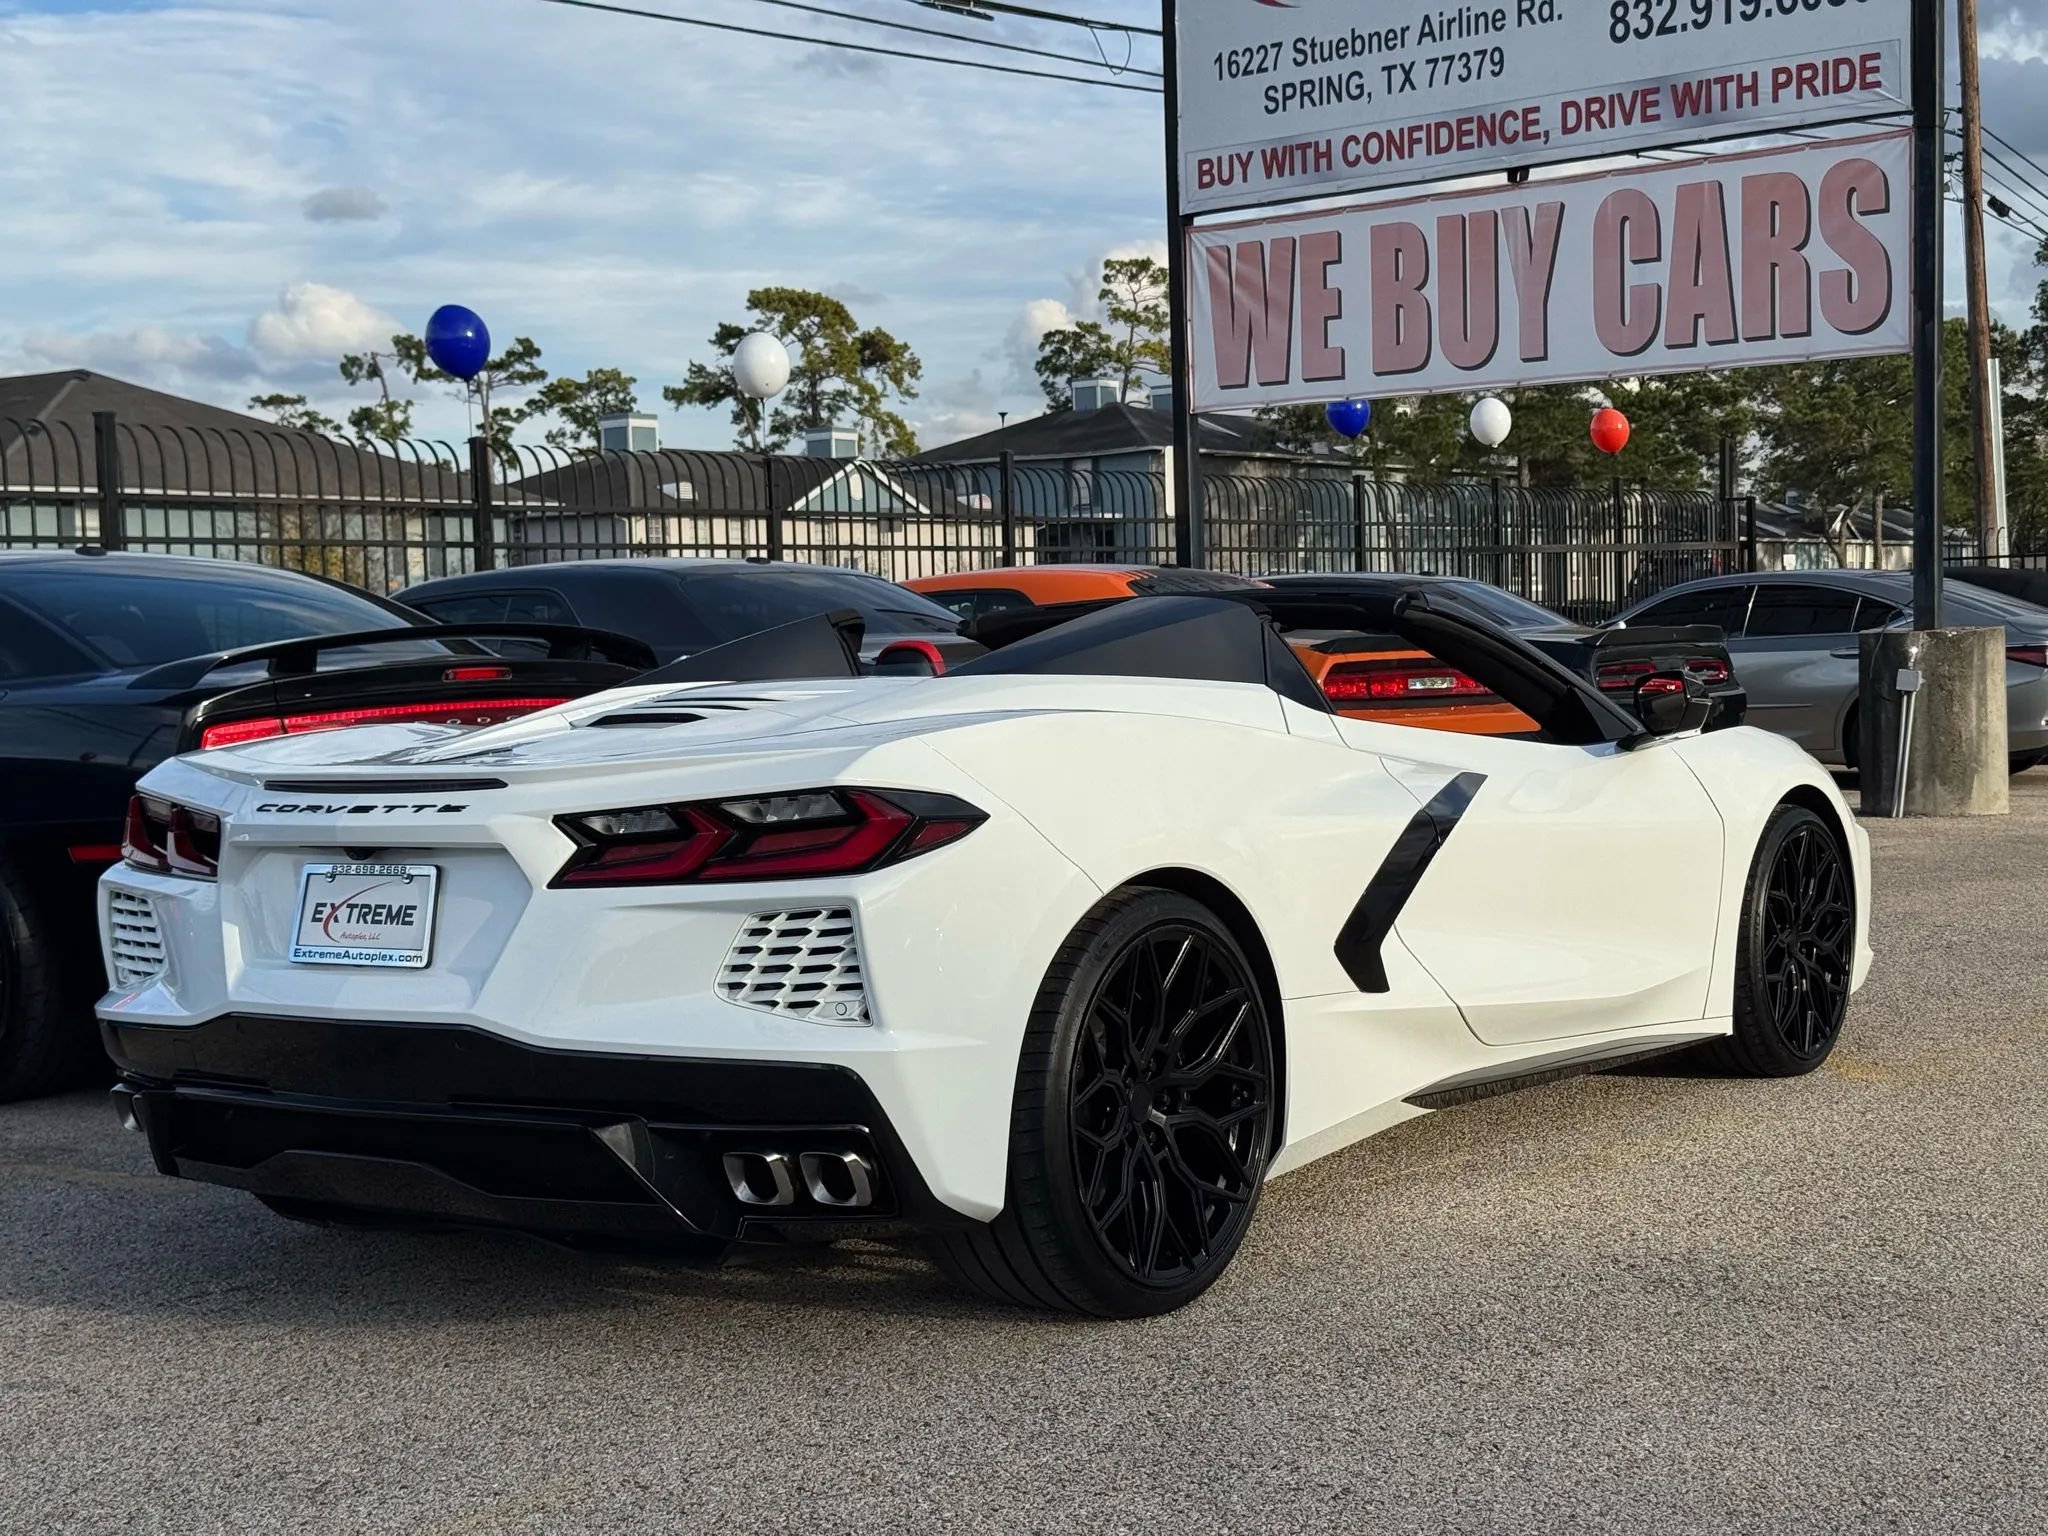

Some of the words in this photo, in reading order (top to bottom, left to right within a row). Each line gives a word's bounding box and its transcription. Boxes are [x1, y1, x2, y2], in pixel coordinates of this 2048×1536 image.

[1213, 42, 1283, 82] 16227
[1292, 25, 1410, 68] Stuebner
[1416, 7, 1507, 47] Airline
[1516, 0, 1564, 28] Rd.
[1263, 71, 1372, 115] SPRING,
[1381, 61, 1417, 95] TX
[1425, 46, 1505, 89] 77379
[1198, 152, 1254, 190] BUY
[1261, 140, 1333, 179] WITH
[1340, 106, 1550, 169] CONFIDENCE,
[1560, 86, 1661, 132] DRIVE
[1670, 71, 1760, 120] WITH
[1771, 52, 1883, 104] PRIDE
[1205, 230, 1346, 390] WE
[1370, 201, 1566, 376] BUY
[1592, 157, 1893, 357] CARS
[255, 803, 470, 814] CORVETTE
[311, 902, 418, 927] EXTREME
[293, 948, 423, 963] ExtremeAutoplex.com
